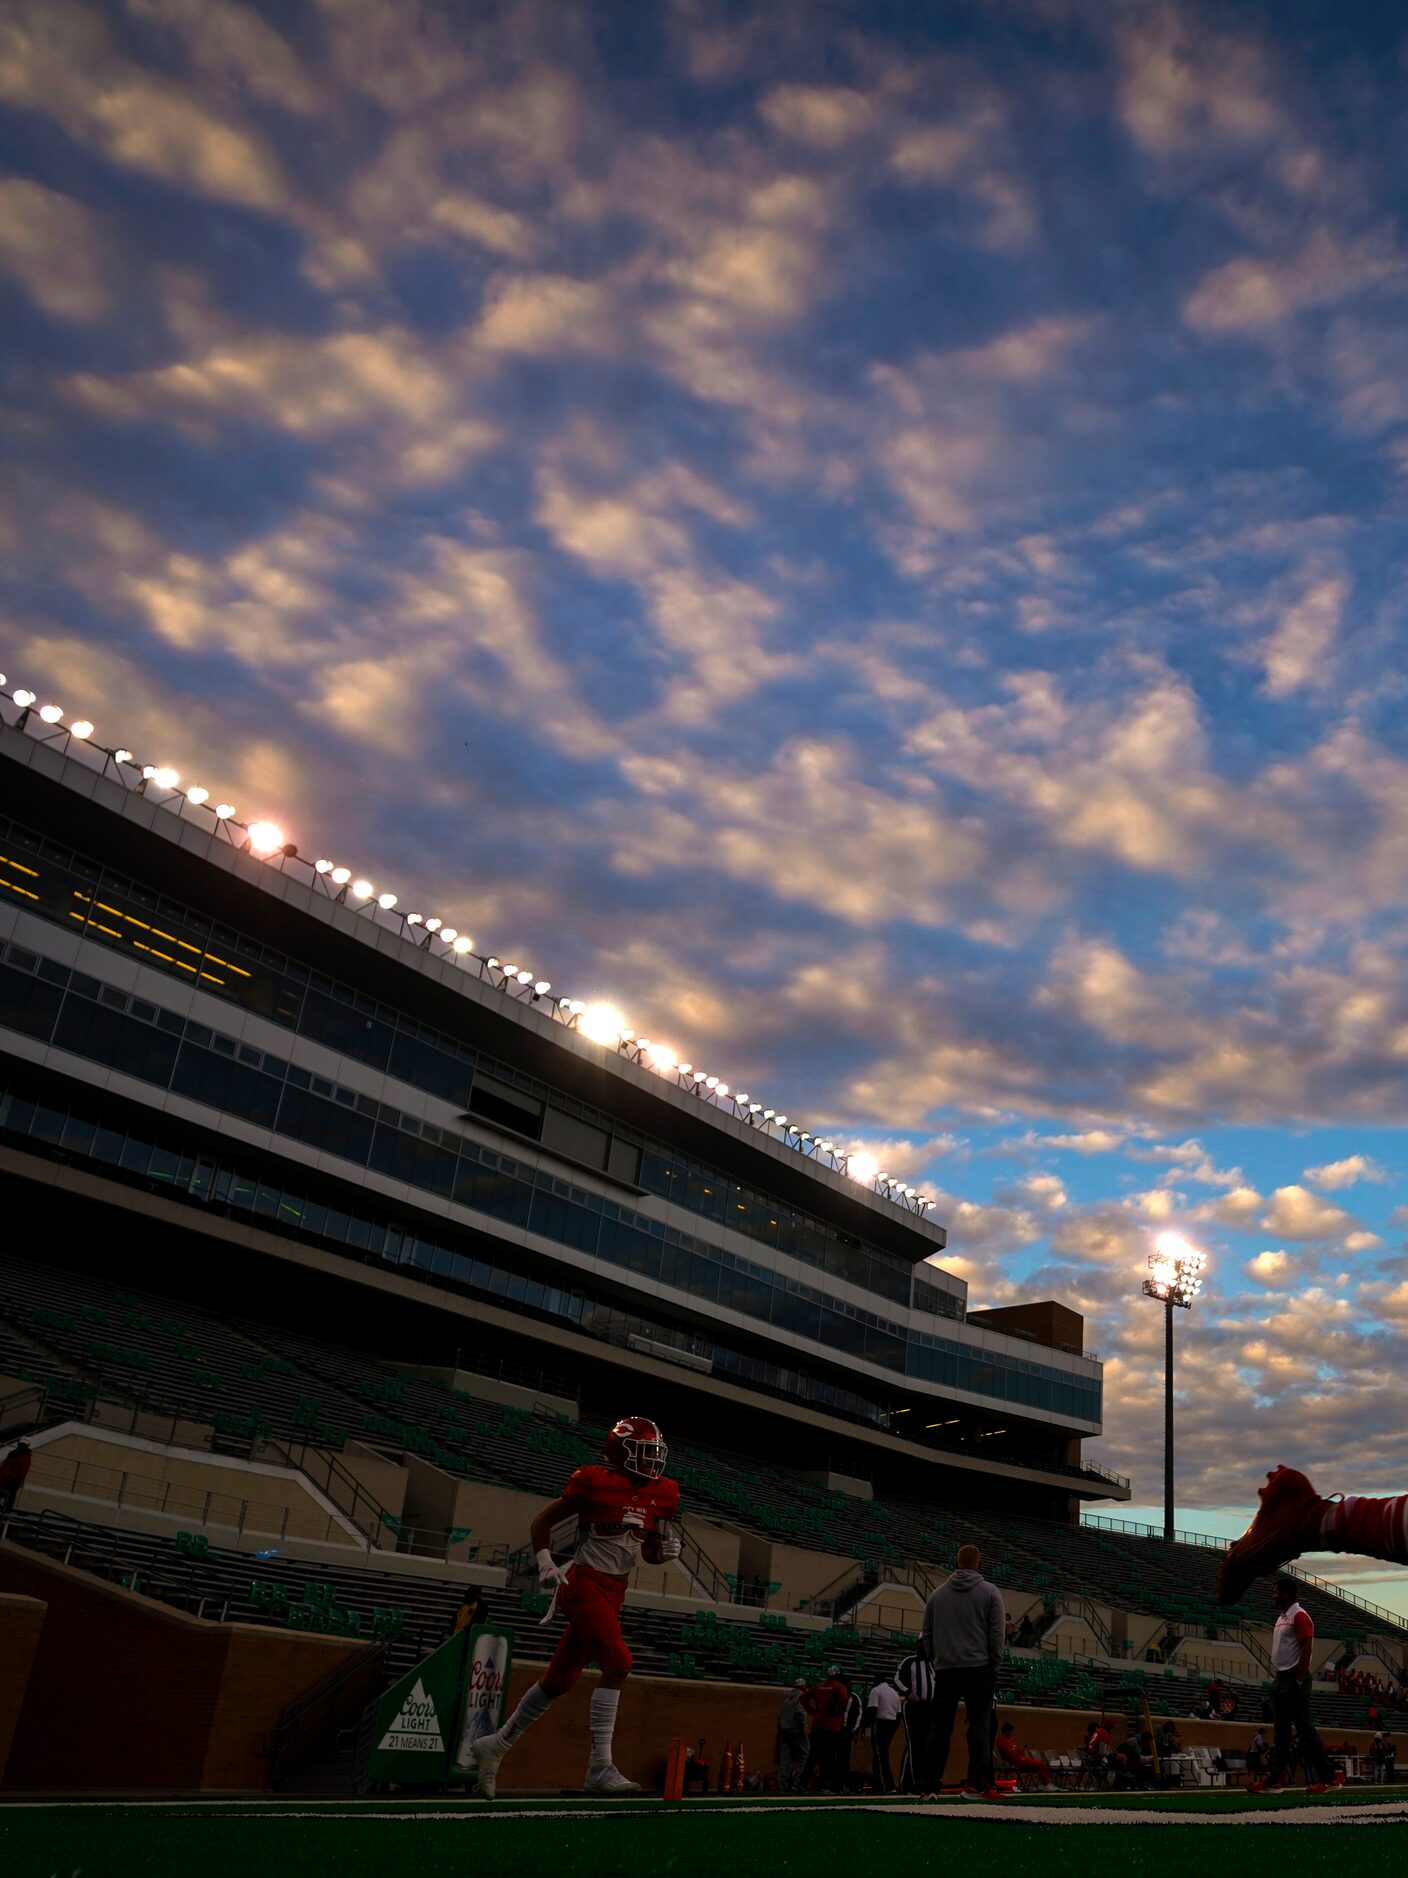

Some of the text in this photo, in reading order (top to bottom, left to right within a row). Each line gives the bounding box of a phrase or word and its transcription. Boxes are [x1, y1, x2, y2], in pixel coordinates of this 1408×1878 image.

[400, 1695, 436, 1718] Coors
[469, 1692, 501, 1709] LIGHT
[401, 1718, 431, 1731] LIGHT
[388, 1735, 438, 1750] 21 MEANS 21
